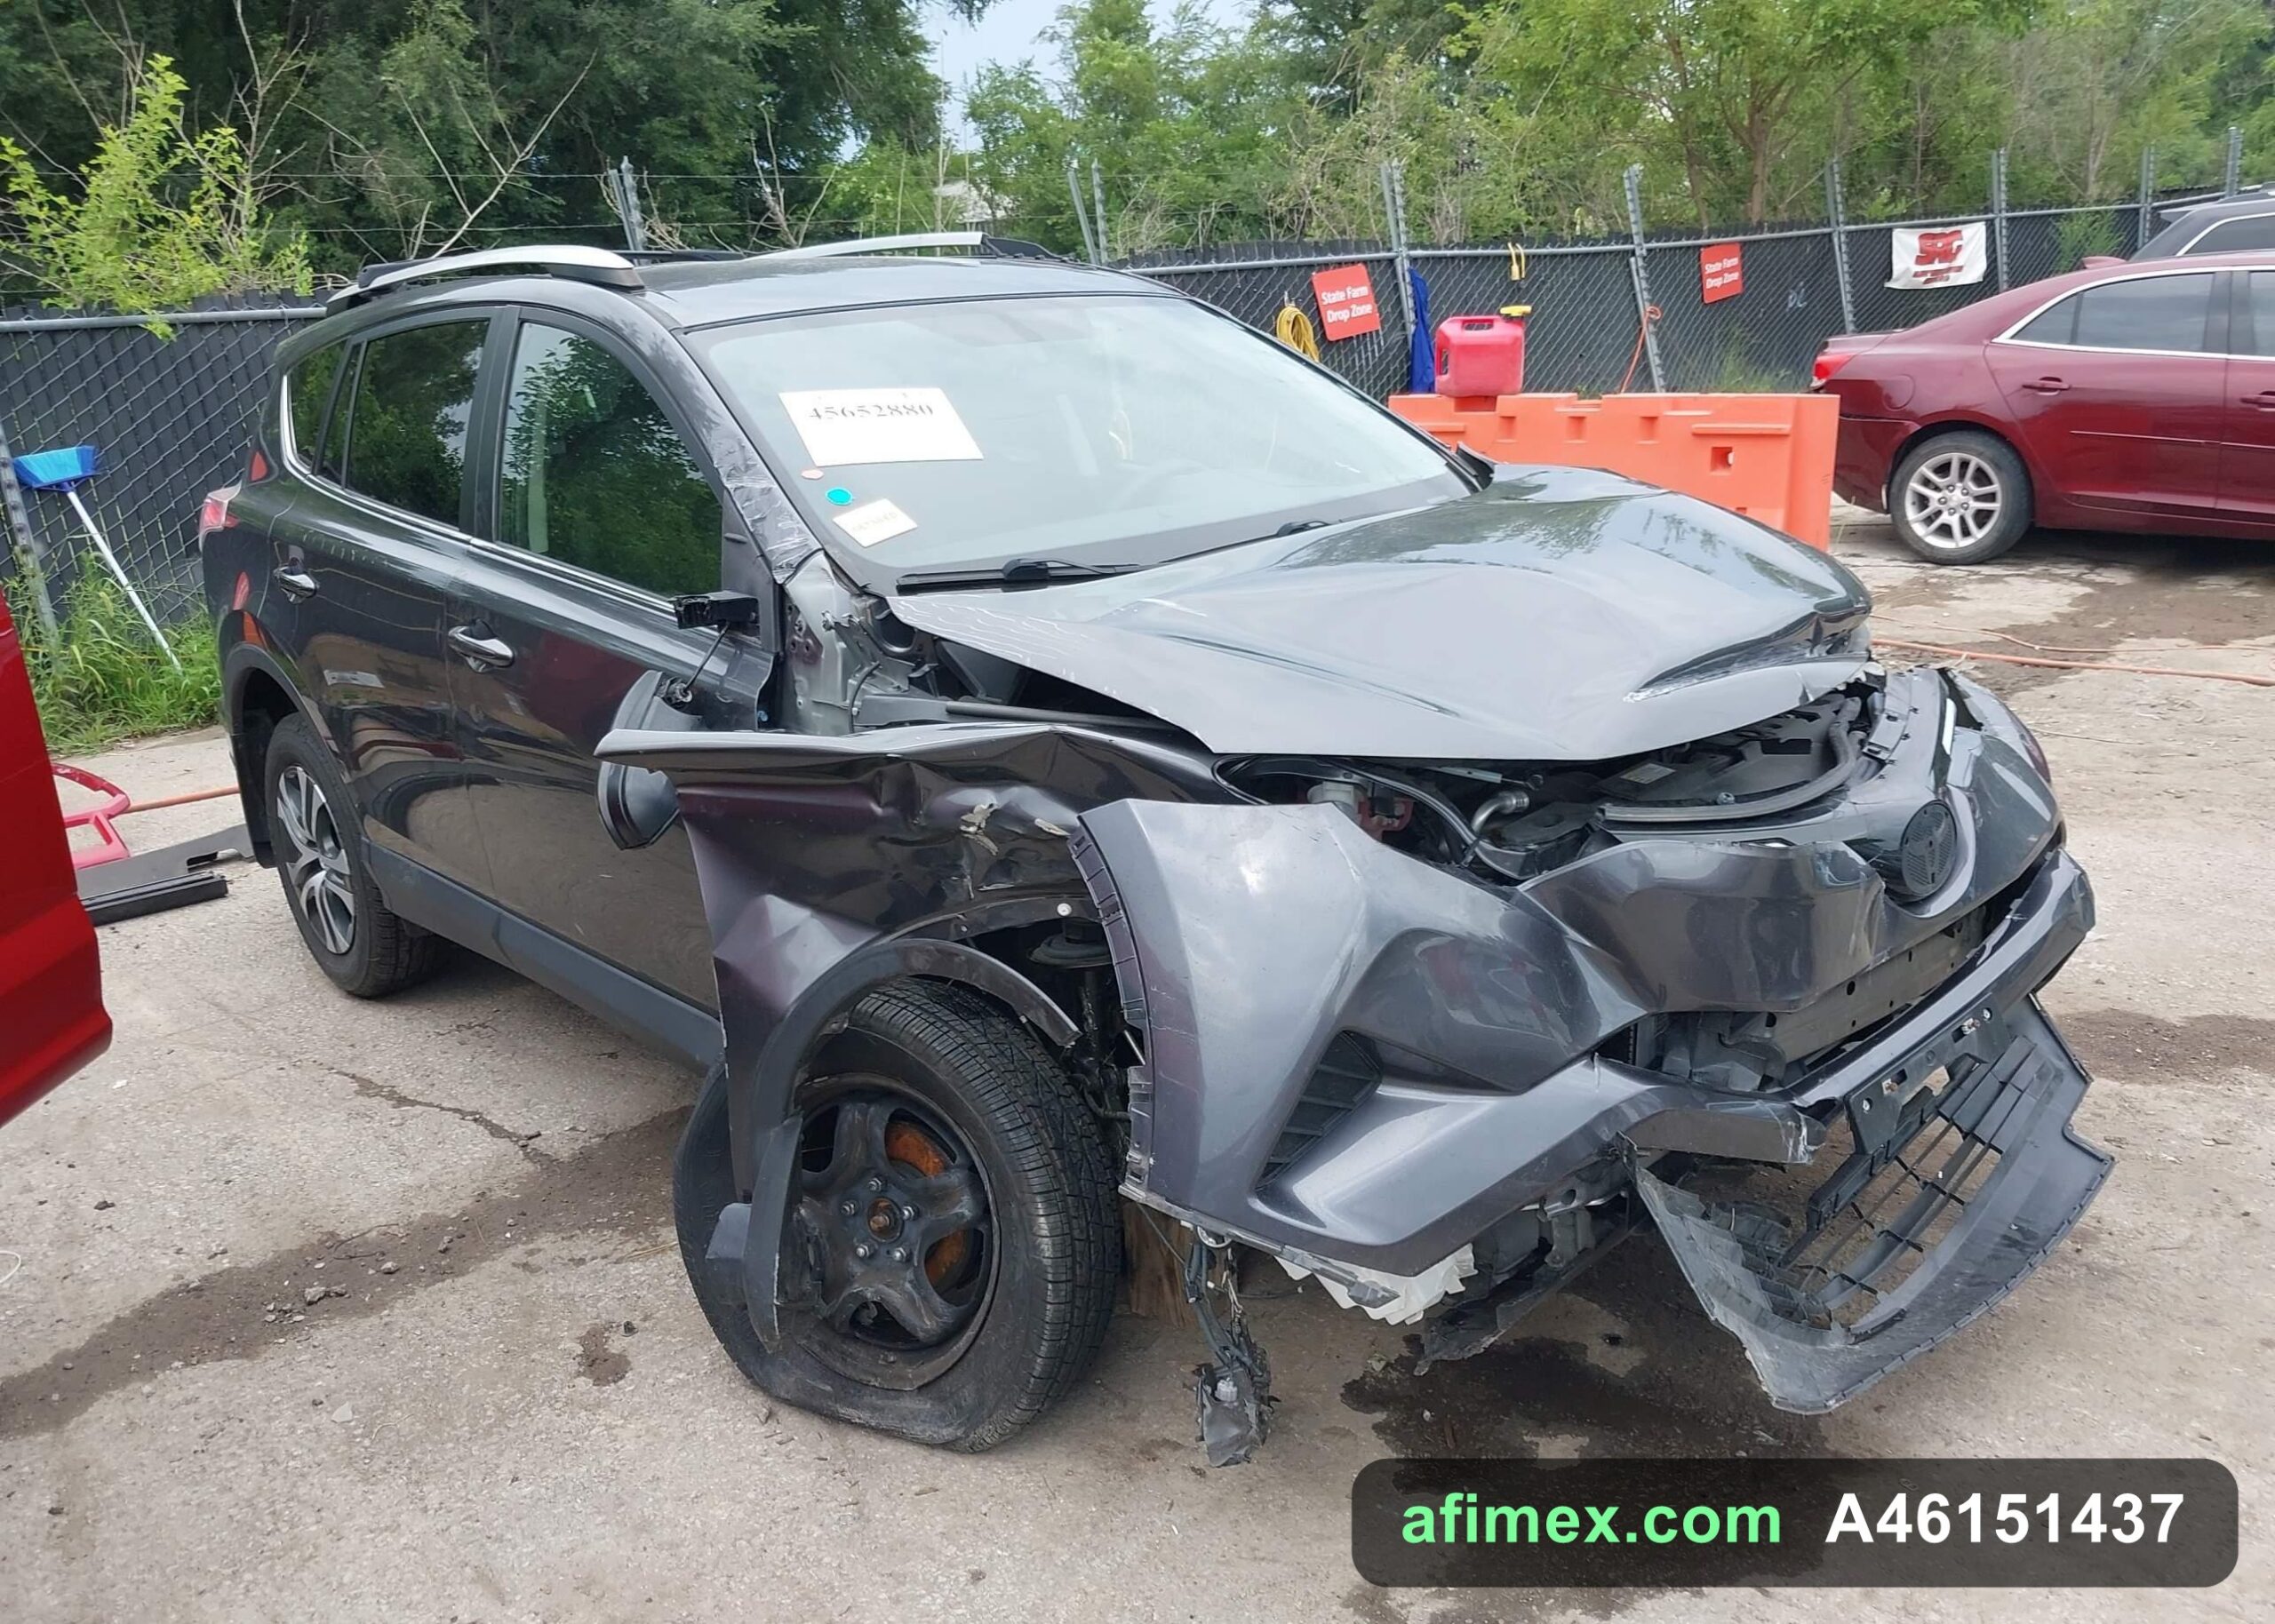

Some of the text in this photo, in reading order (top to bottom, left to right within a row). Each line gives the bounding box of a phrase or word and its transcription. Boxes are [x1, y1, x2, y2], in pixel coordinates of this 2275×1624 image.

[1321, 286, 1369, 305] State Farm
[1327, 304, 1373, 323] Drop Zone
[808, 403, 934, 420] 45652880
